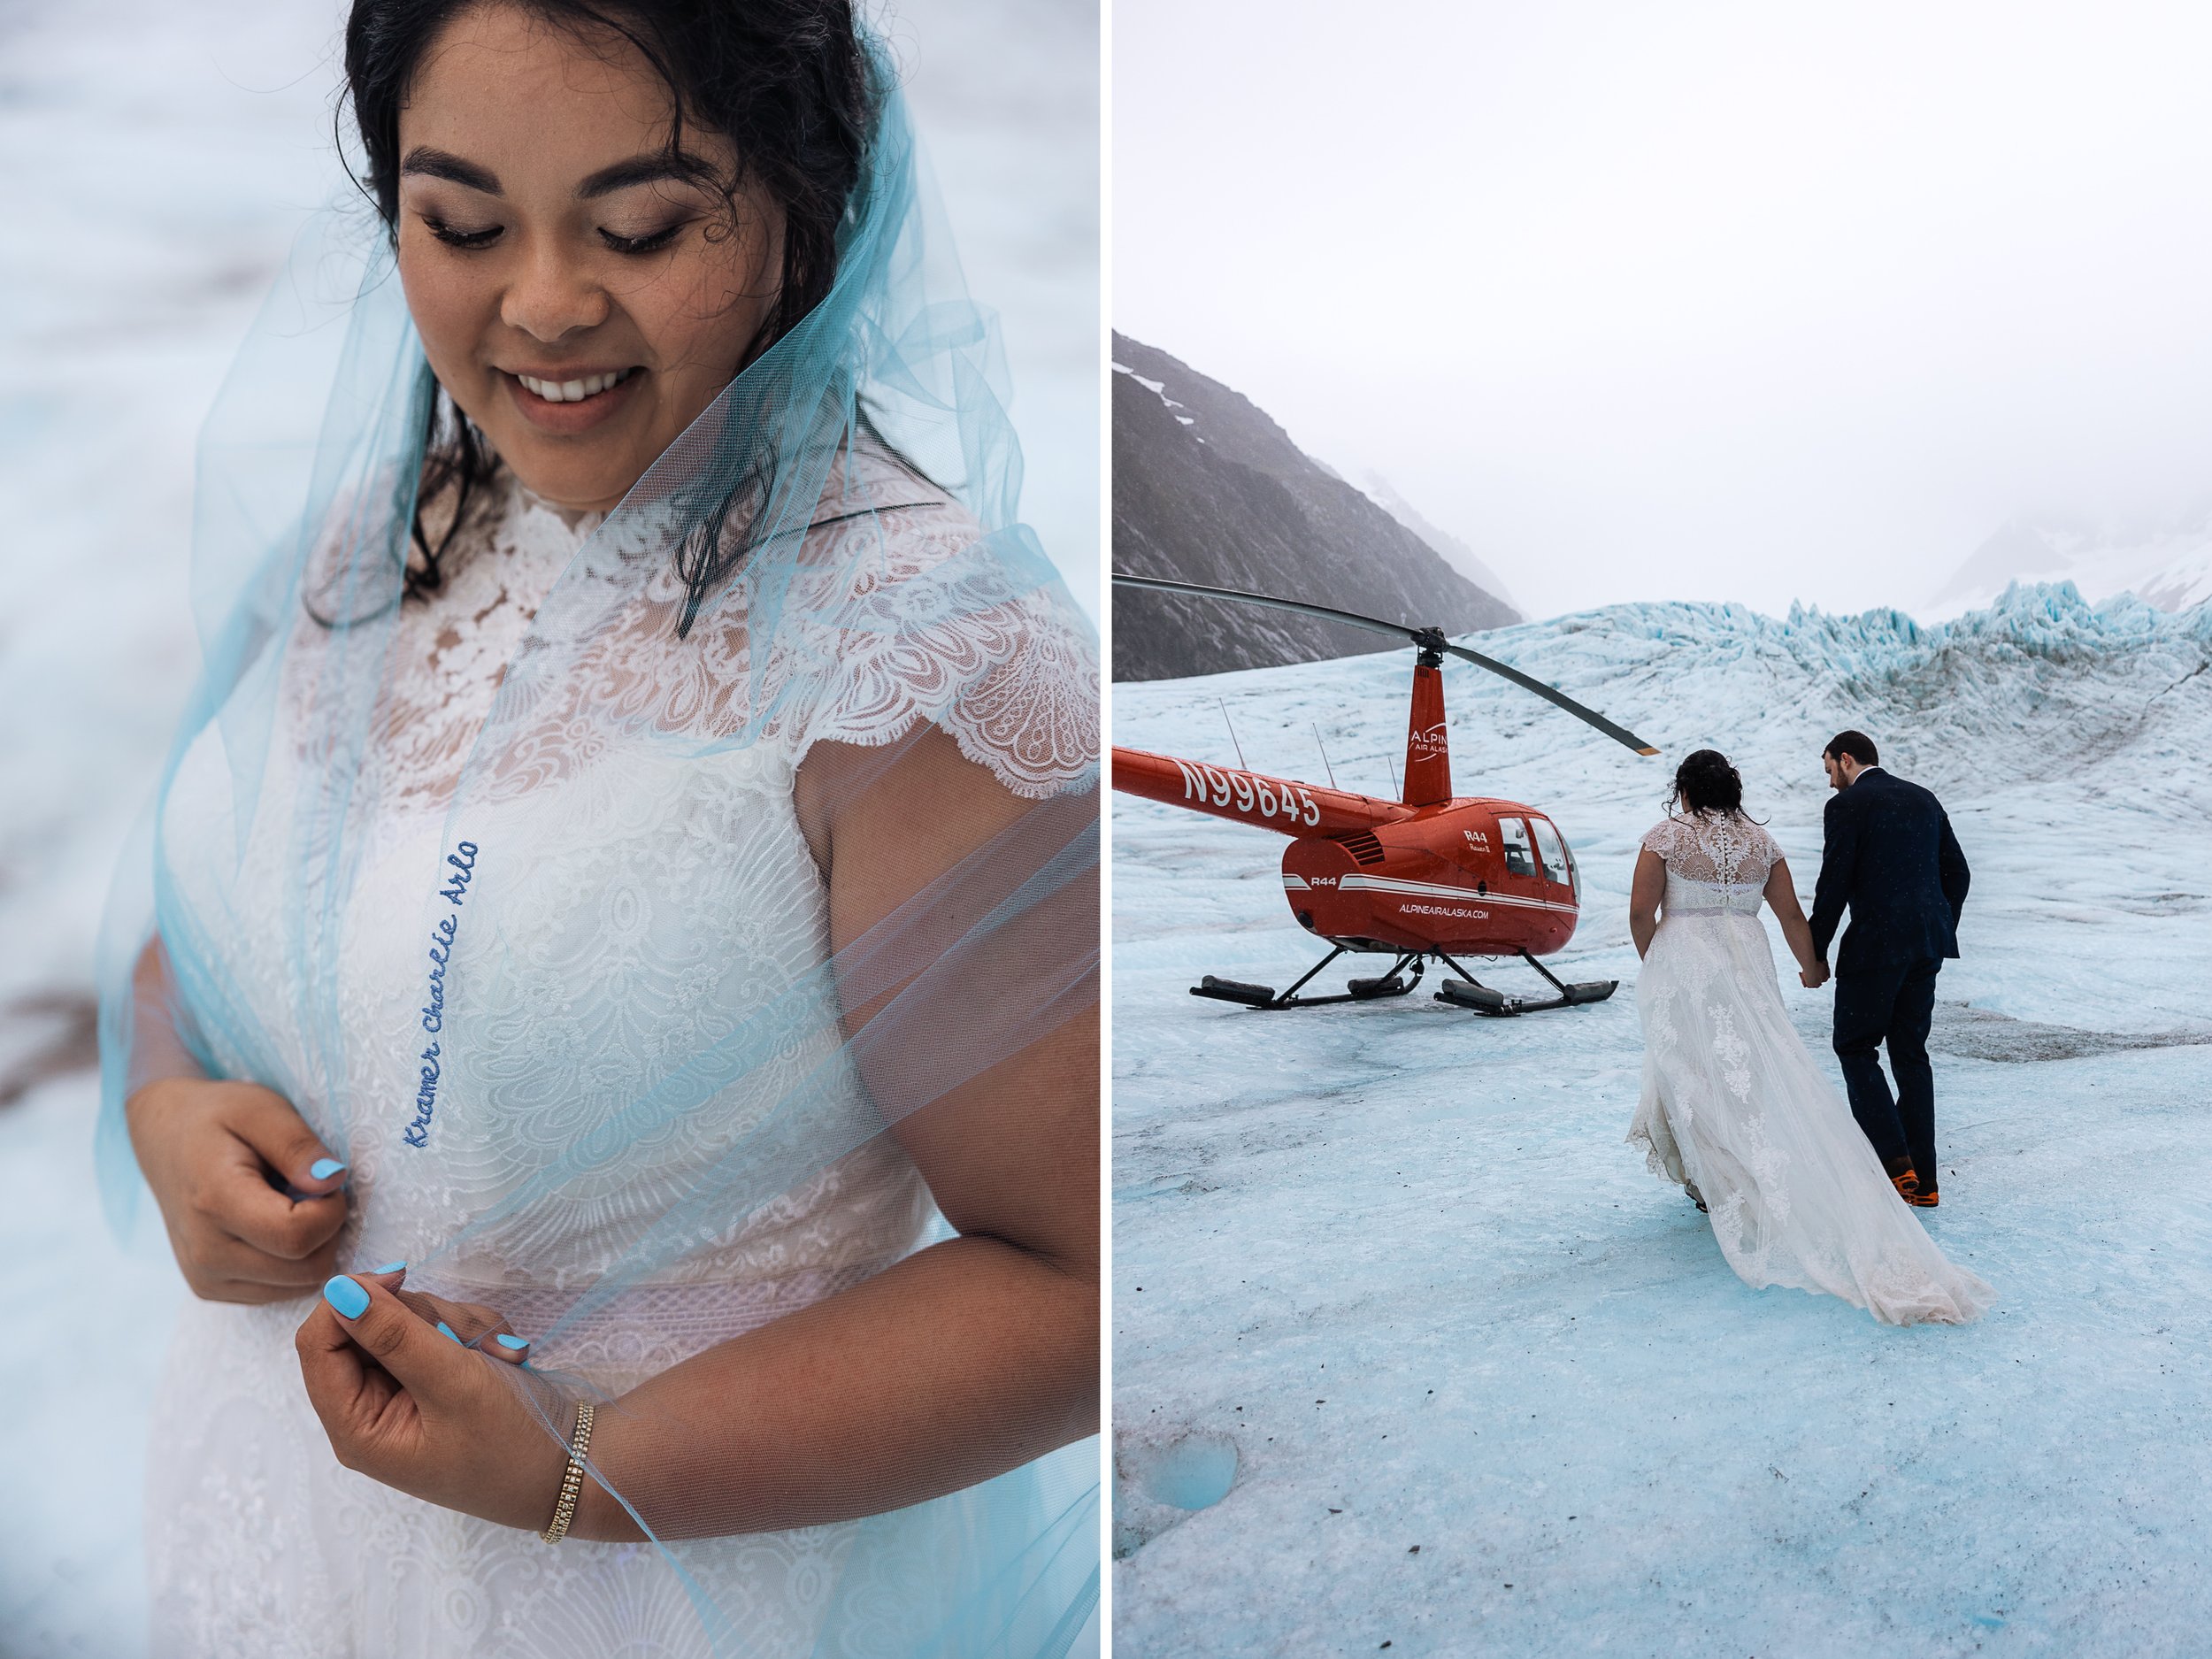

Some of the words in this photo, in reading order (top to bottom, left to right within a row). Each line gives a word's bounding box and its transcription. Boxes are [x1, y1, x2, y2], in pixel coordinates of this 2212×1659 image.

[1172, 758, 1320, 826] N99645
[1463, 830, 1488, 843] R44
[439, 840, 479, 906] Arlo
[1311, 877, 1337, 886] R44
[1399, 903, 1489, 920] ALPINEAIRALASKA.COM
[422, 914, 457, 1033] Charlie
[403, 1041, 441, 1148] Kramer
